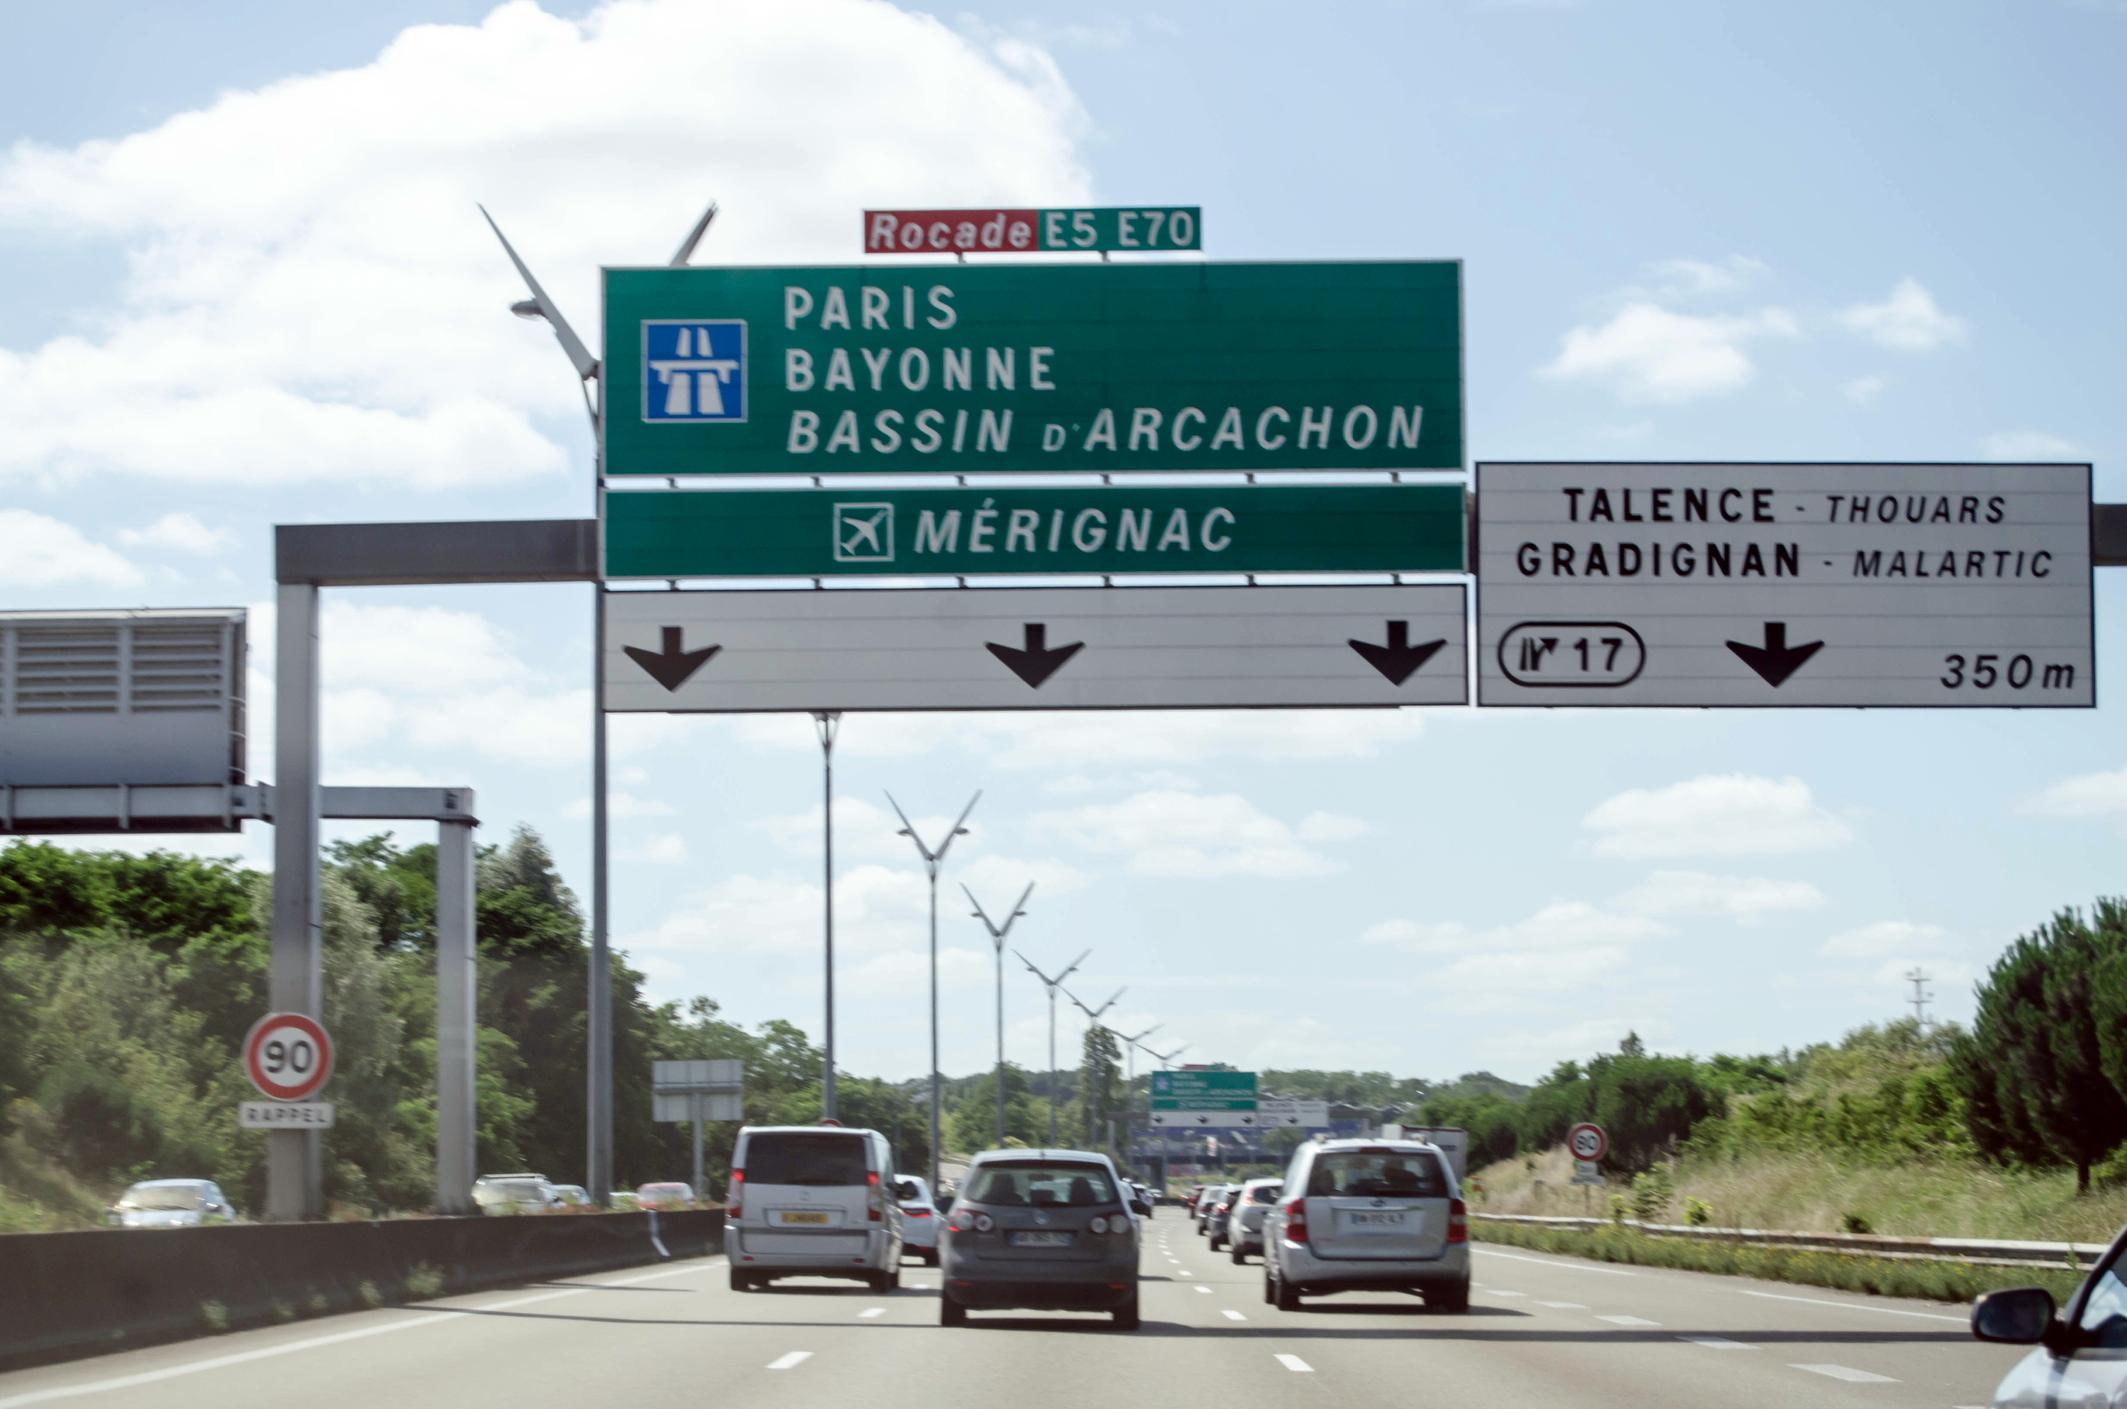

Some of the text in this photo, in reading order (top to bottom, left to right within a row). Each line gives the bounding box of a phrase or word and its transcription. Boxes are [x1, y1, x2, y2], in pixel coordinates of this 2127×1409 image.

[868, 210, 1194, 249] Rocade E5 E70
[785, 285, 957, 330] PARIS
[785, 346, 1055, 392] BAYONNE
[787, 408, 1013, 454] BASSIN
[1562, 487, 1775, 523] TALENCE
[1827, 495, 2005, 525] THOUARS
[914, 497, 1235, 554] MÉRIGNAC
[1516, 542, 1799, 577] GRADIGNAN
[1853, 550, 2053, 578] MALARTIC
[1573, 637, 1623, 672] 17
[265, 1040, 313, 1074] 90
[247, 1107, 328, 1123] RAPPEL
